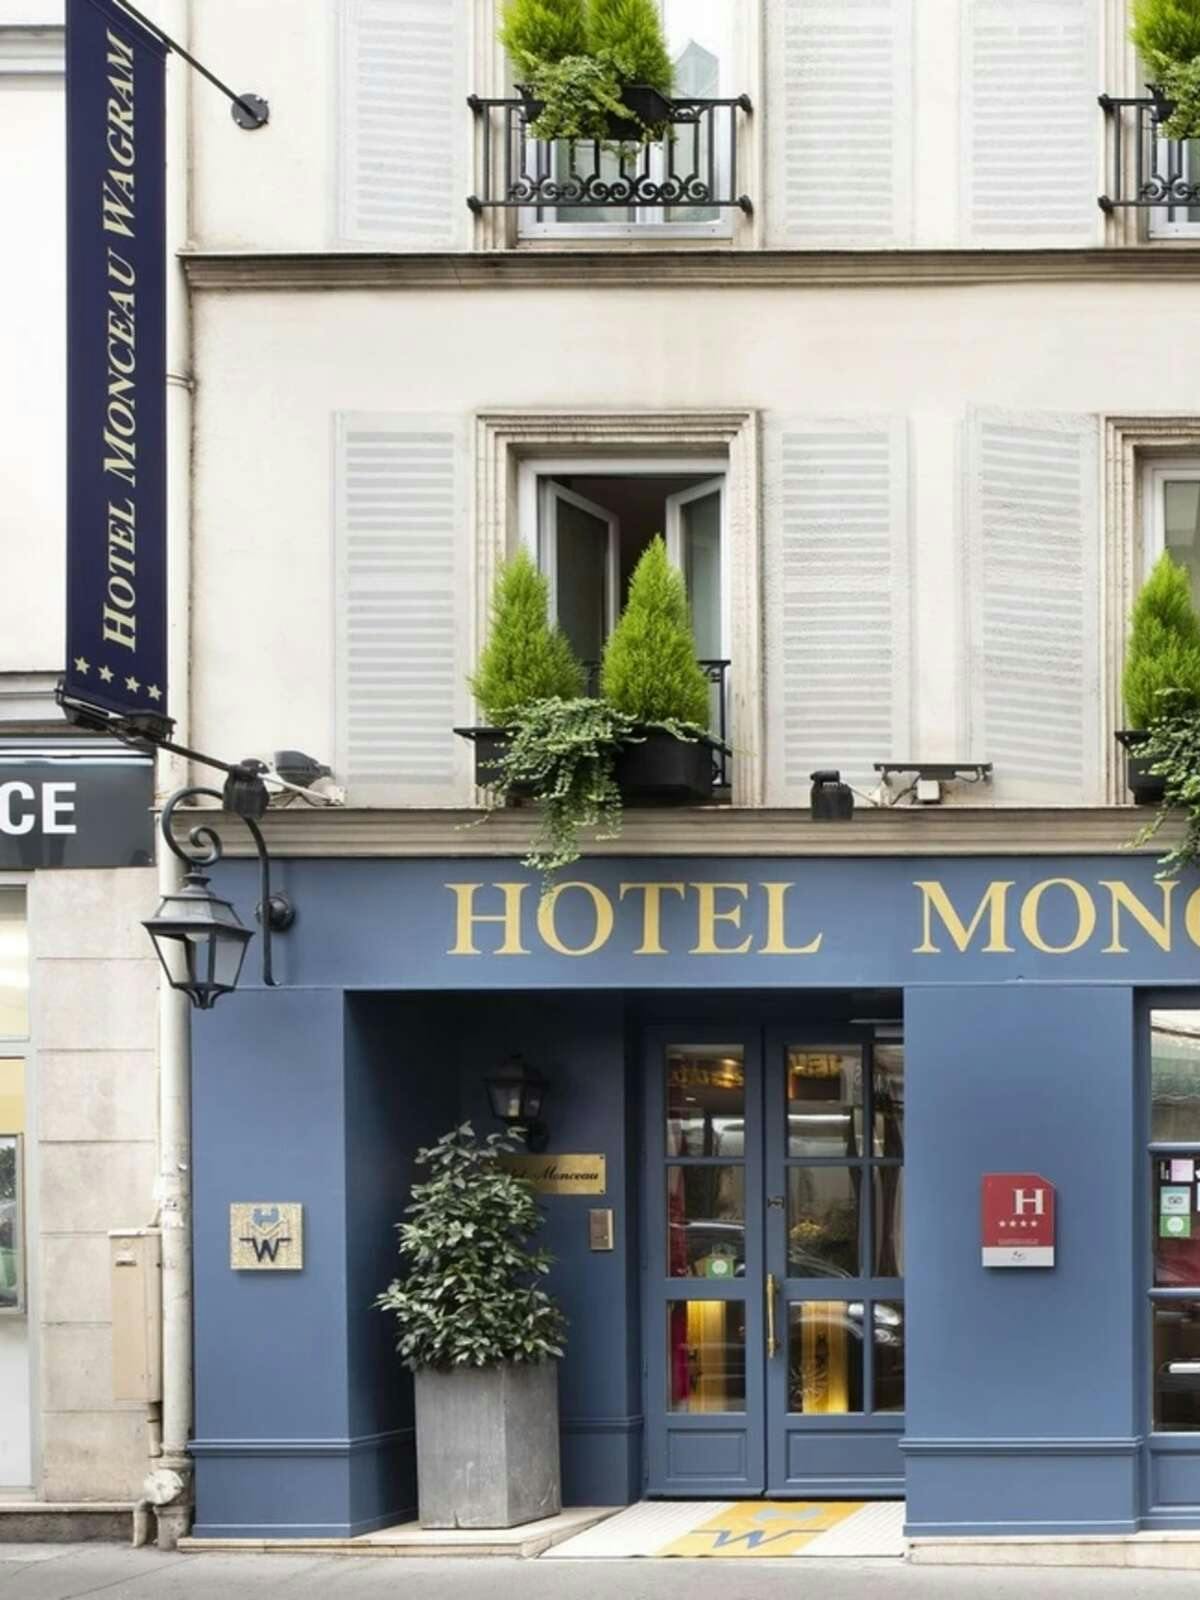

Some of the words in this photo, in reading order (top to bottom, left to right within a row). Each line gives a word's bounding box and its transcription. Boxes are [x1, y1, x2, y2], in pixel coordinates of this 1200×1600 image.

[103, 27, 136, 238] WAGRAM
[103, 246, 137, 489] MONCEAU
[103, 497, 137, 653] HOTEL
[0, 780, 78, 836] CE
[443, 880, 824, 956] HOTEL
[1012, 1188, 1046, 1216] H
